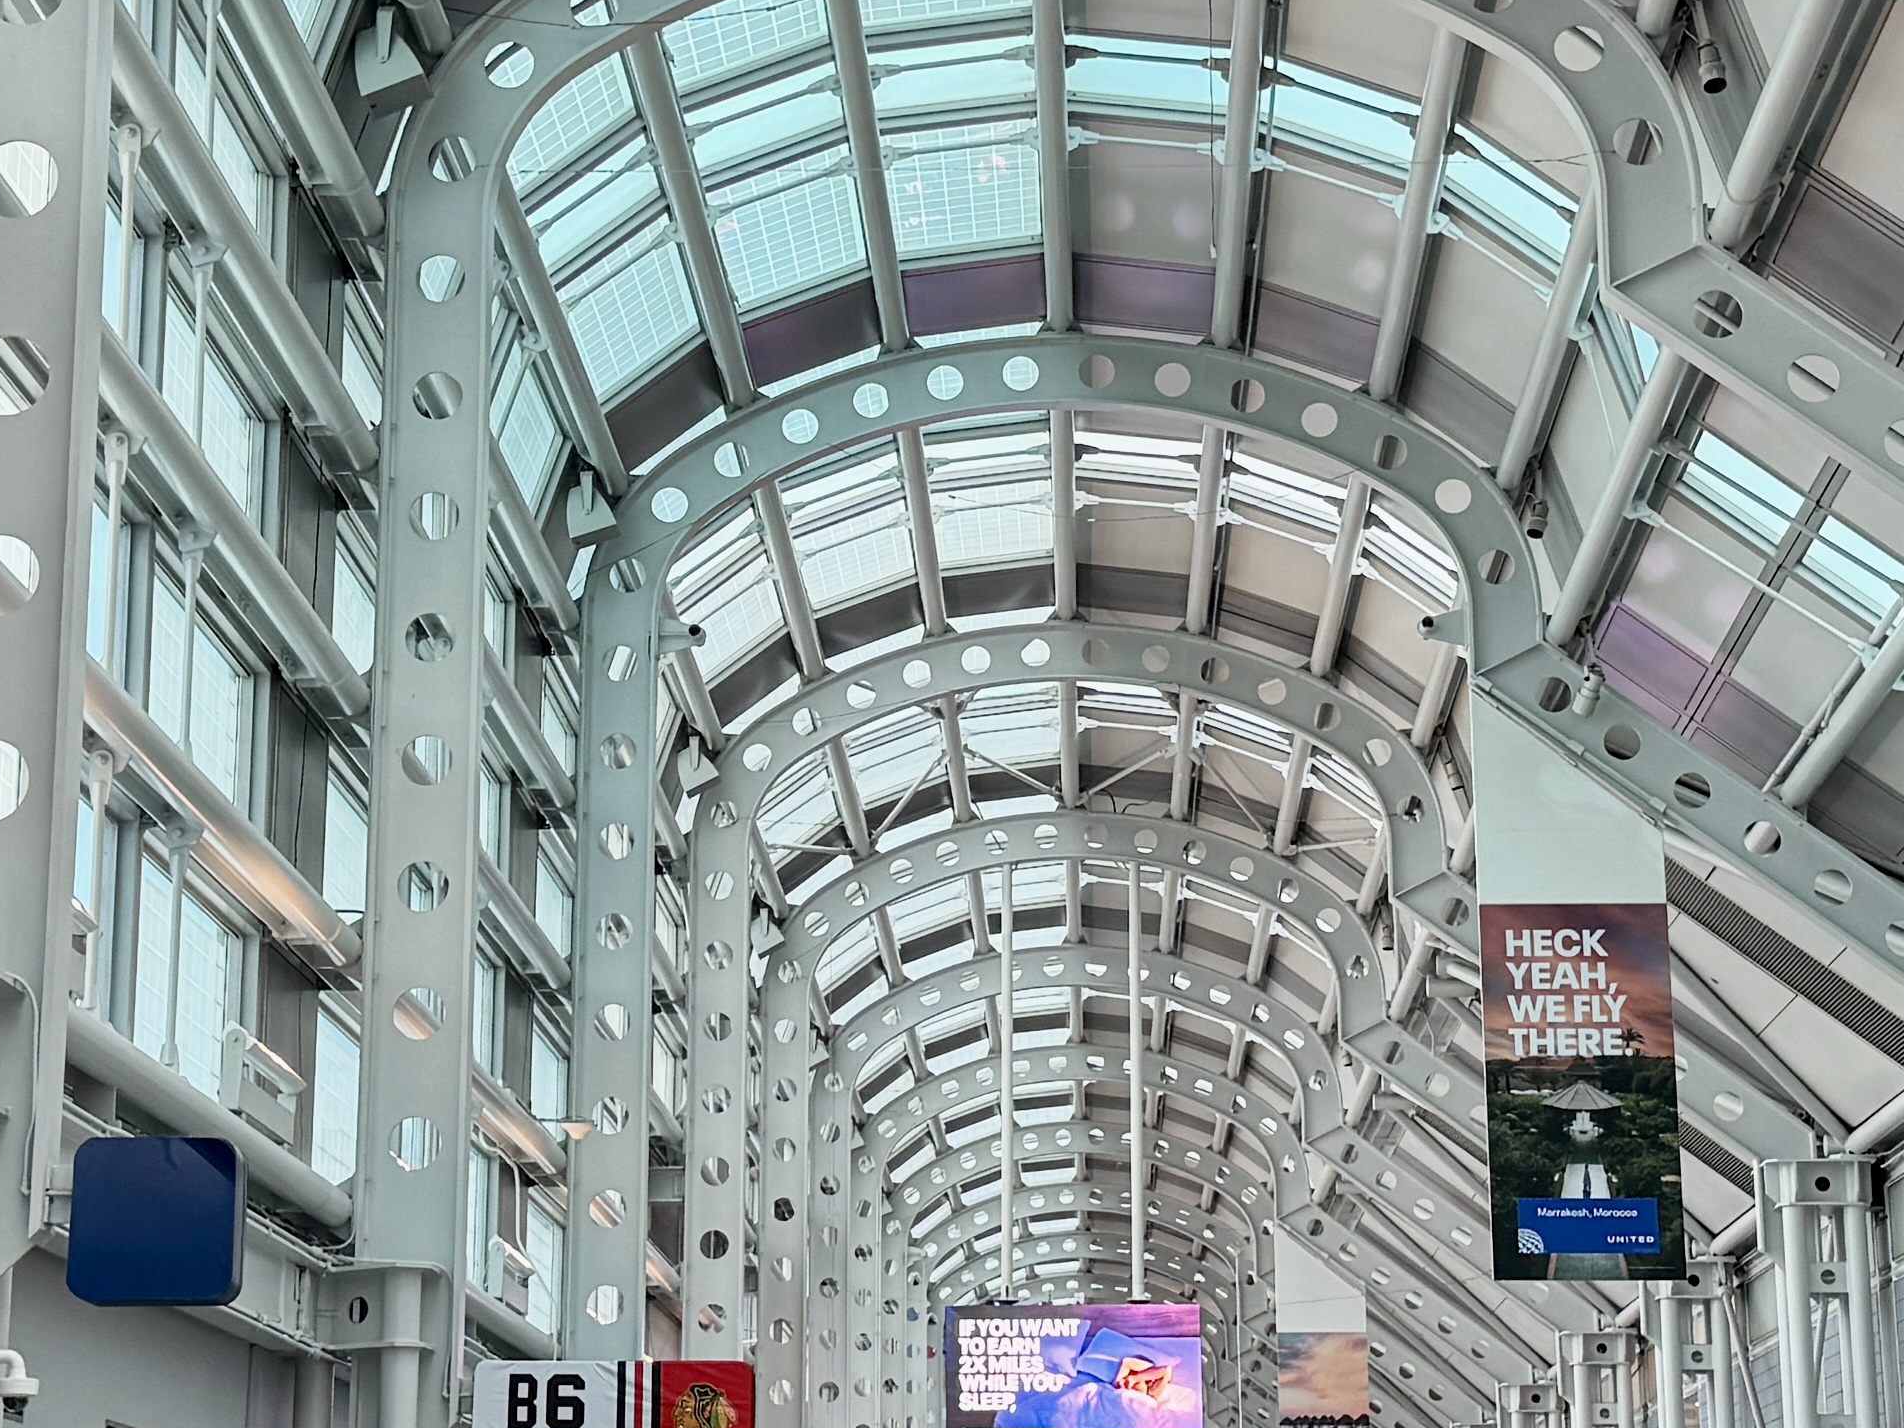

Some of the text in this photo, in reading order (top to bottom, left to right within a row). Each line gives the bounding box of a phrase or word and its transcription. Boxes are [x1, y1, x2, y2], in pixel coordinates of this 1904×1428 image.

[1505, 928, 1609, 958] HECK
[1505, 962, 1619, 996] YEAH,
[1506, 995, 1628, 1023] WE FLY
[1508, 1028, 1634, 1058] THERE.
[1594, 1207, 1638, 1218] Morocco
[1607, 1235, 1655, 1243] UNITED
[959, 1319, 1080, 1337] IF YOU WANT
[959, 1338, 1040, 1355] TO EARN
[959, 1356, 1044, 1374] 2X MILES
[959, 1374, 1064, 1392] WHILE YOU
[959, 1392, 1017, 1413] SLEEP,
